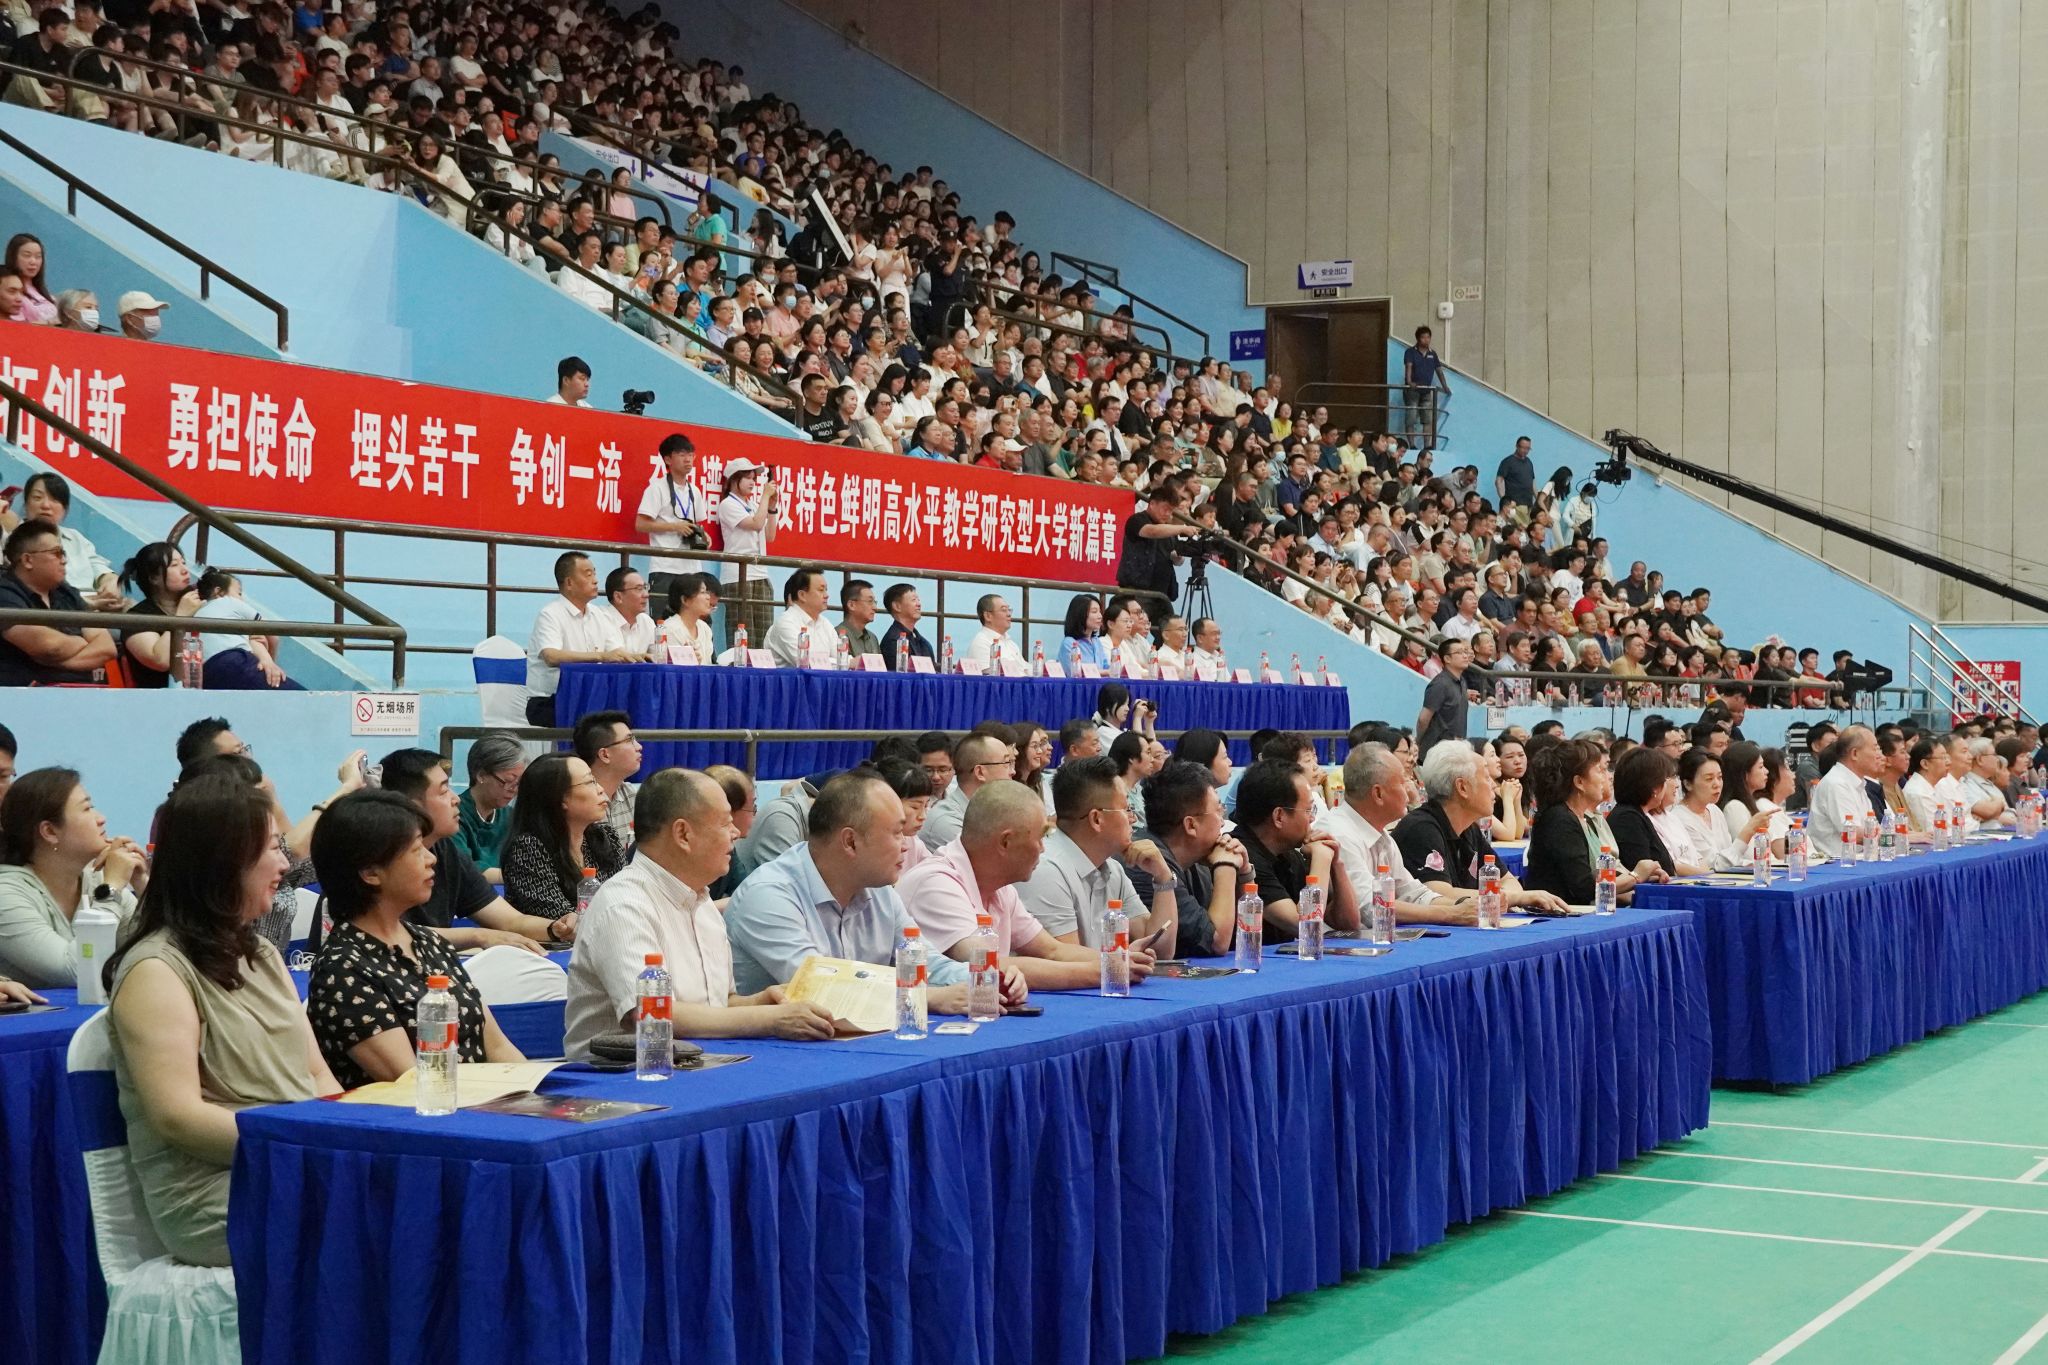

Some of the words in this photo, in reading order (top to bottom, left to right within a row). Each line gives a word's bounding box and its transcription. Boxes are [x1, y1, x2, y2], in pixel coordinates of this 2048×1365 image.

[167, 382, 317, 484] 勇担使命
[350, 408, 480, 499] 埋头苦干
[509, 427, 623, 514] 争创一流
[649, 452, 1117, 566] 谱建设特色鲜明高水平教学研究型大学新篇章
[376, 701, 415, 714] 无烟场所
